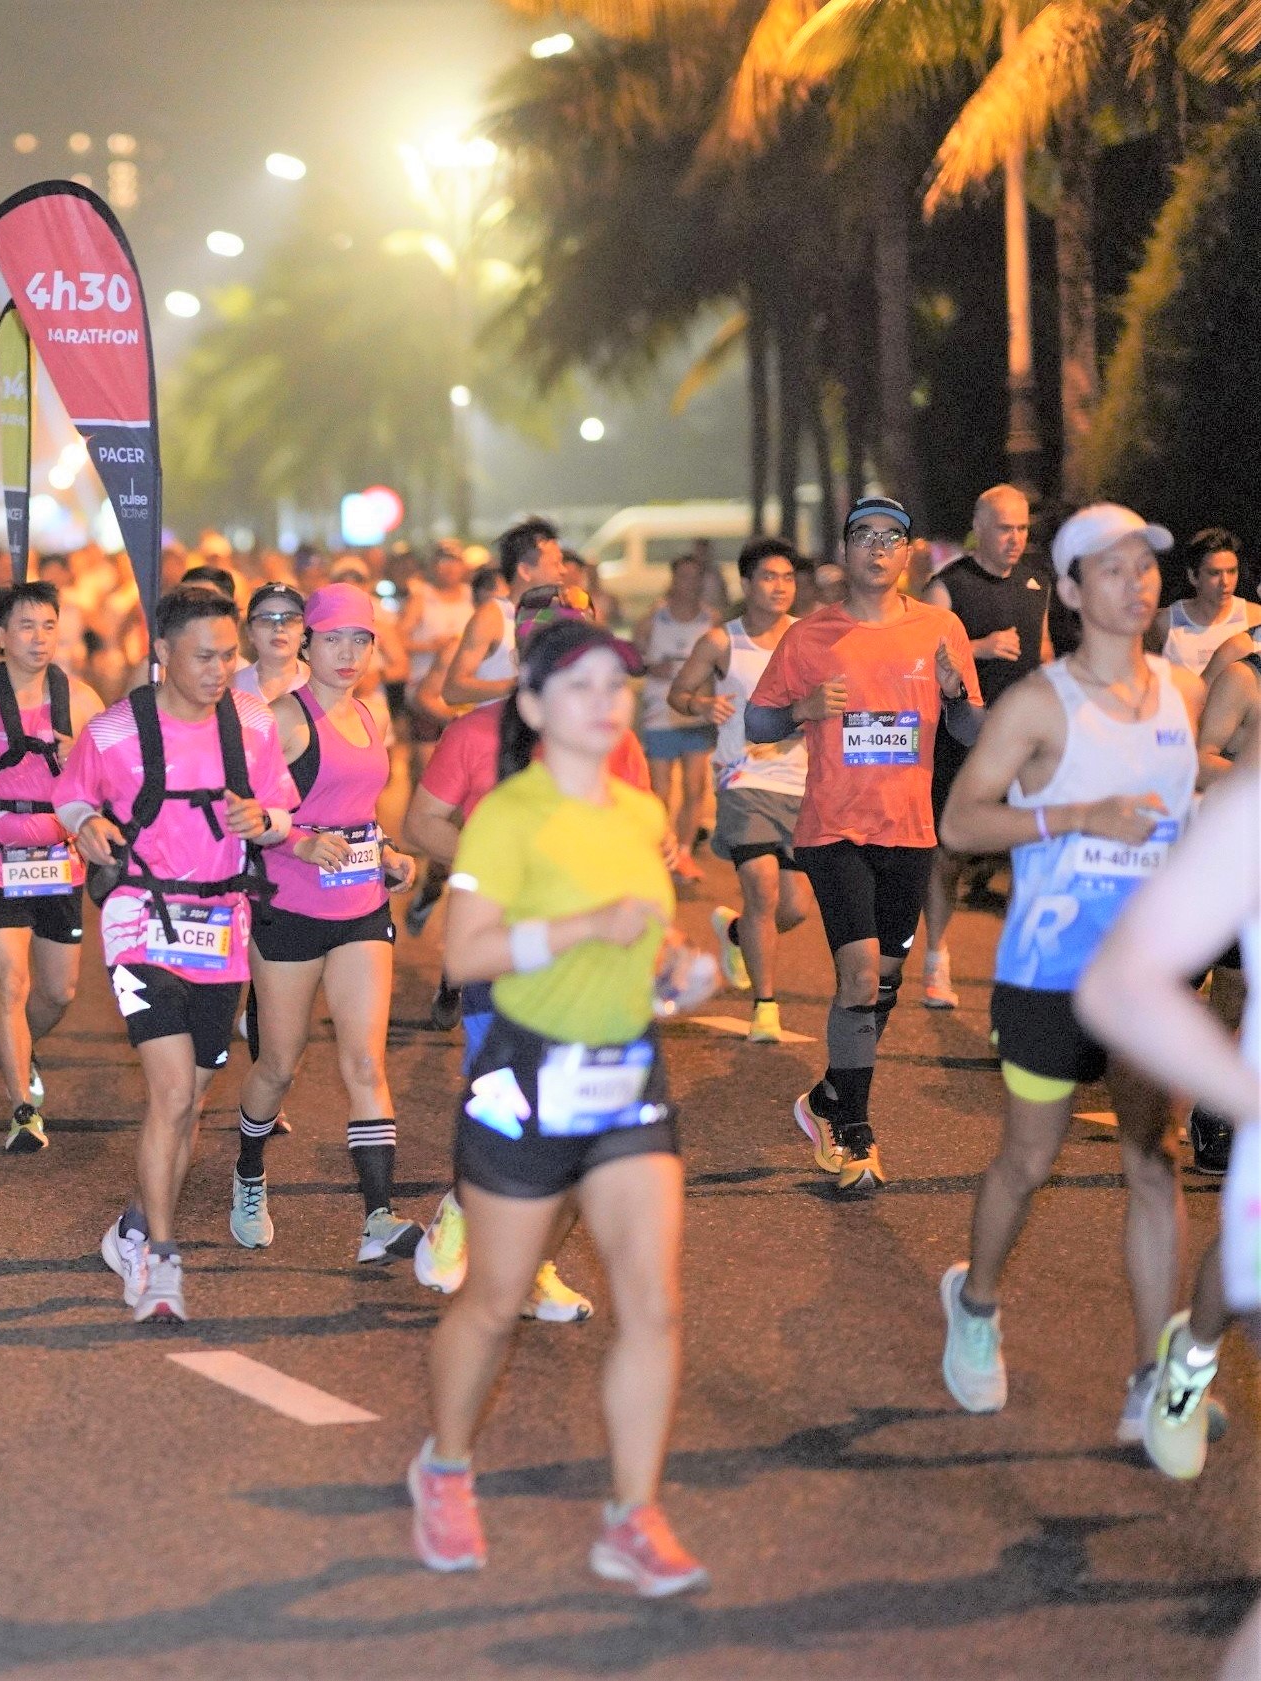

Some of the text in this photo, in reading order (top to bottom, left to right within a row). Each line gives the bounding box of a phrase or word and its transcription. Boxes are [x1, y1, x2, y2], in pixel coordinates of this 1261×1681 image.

[25, 271, 131, 312] 4h30
[99, 448, 145, 463] PACER
[119, 478, 148, 505] pulse
[121, 505, 148, 519] active
[848, 734, 907, 746] M-40426
[9, 866, 58, 880] PACER
[155, 927, 215, 948] PCER
